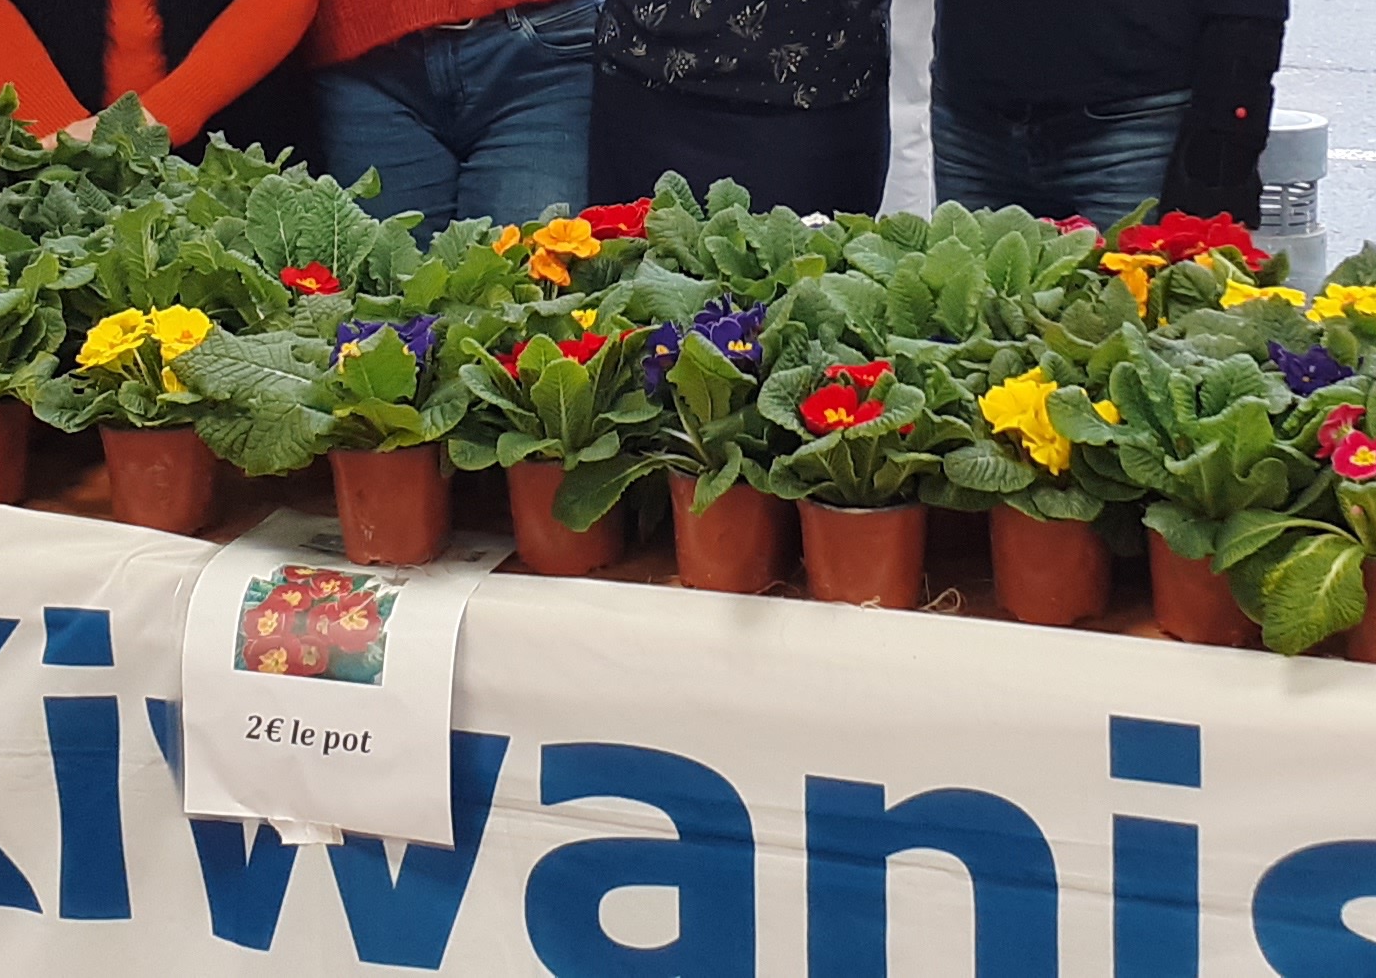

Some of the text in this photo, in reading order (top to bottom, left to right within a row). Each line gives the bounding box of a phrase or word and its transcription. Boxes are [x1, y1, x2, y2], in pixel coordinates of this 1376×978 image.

[245, 714, 373, 756] 2€ le pot
